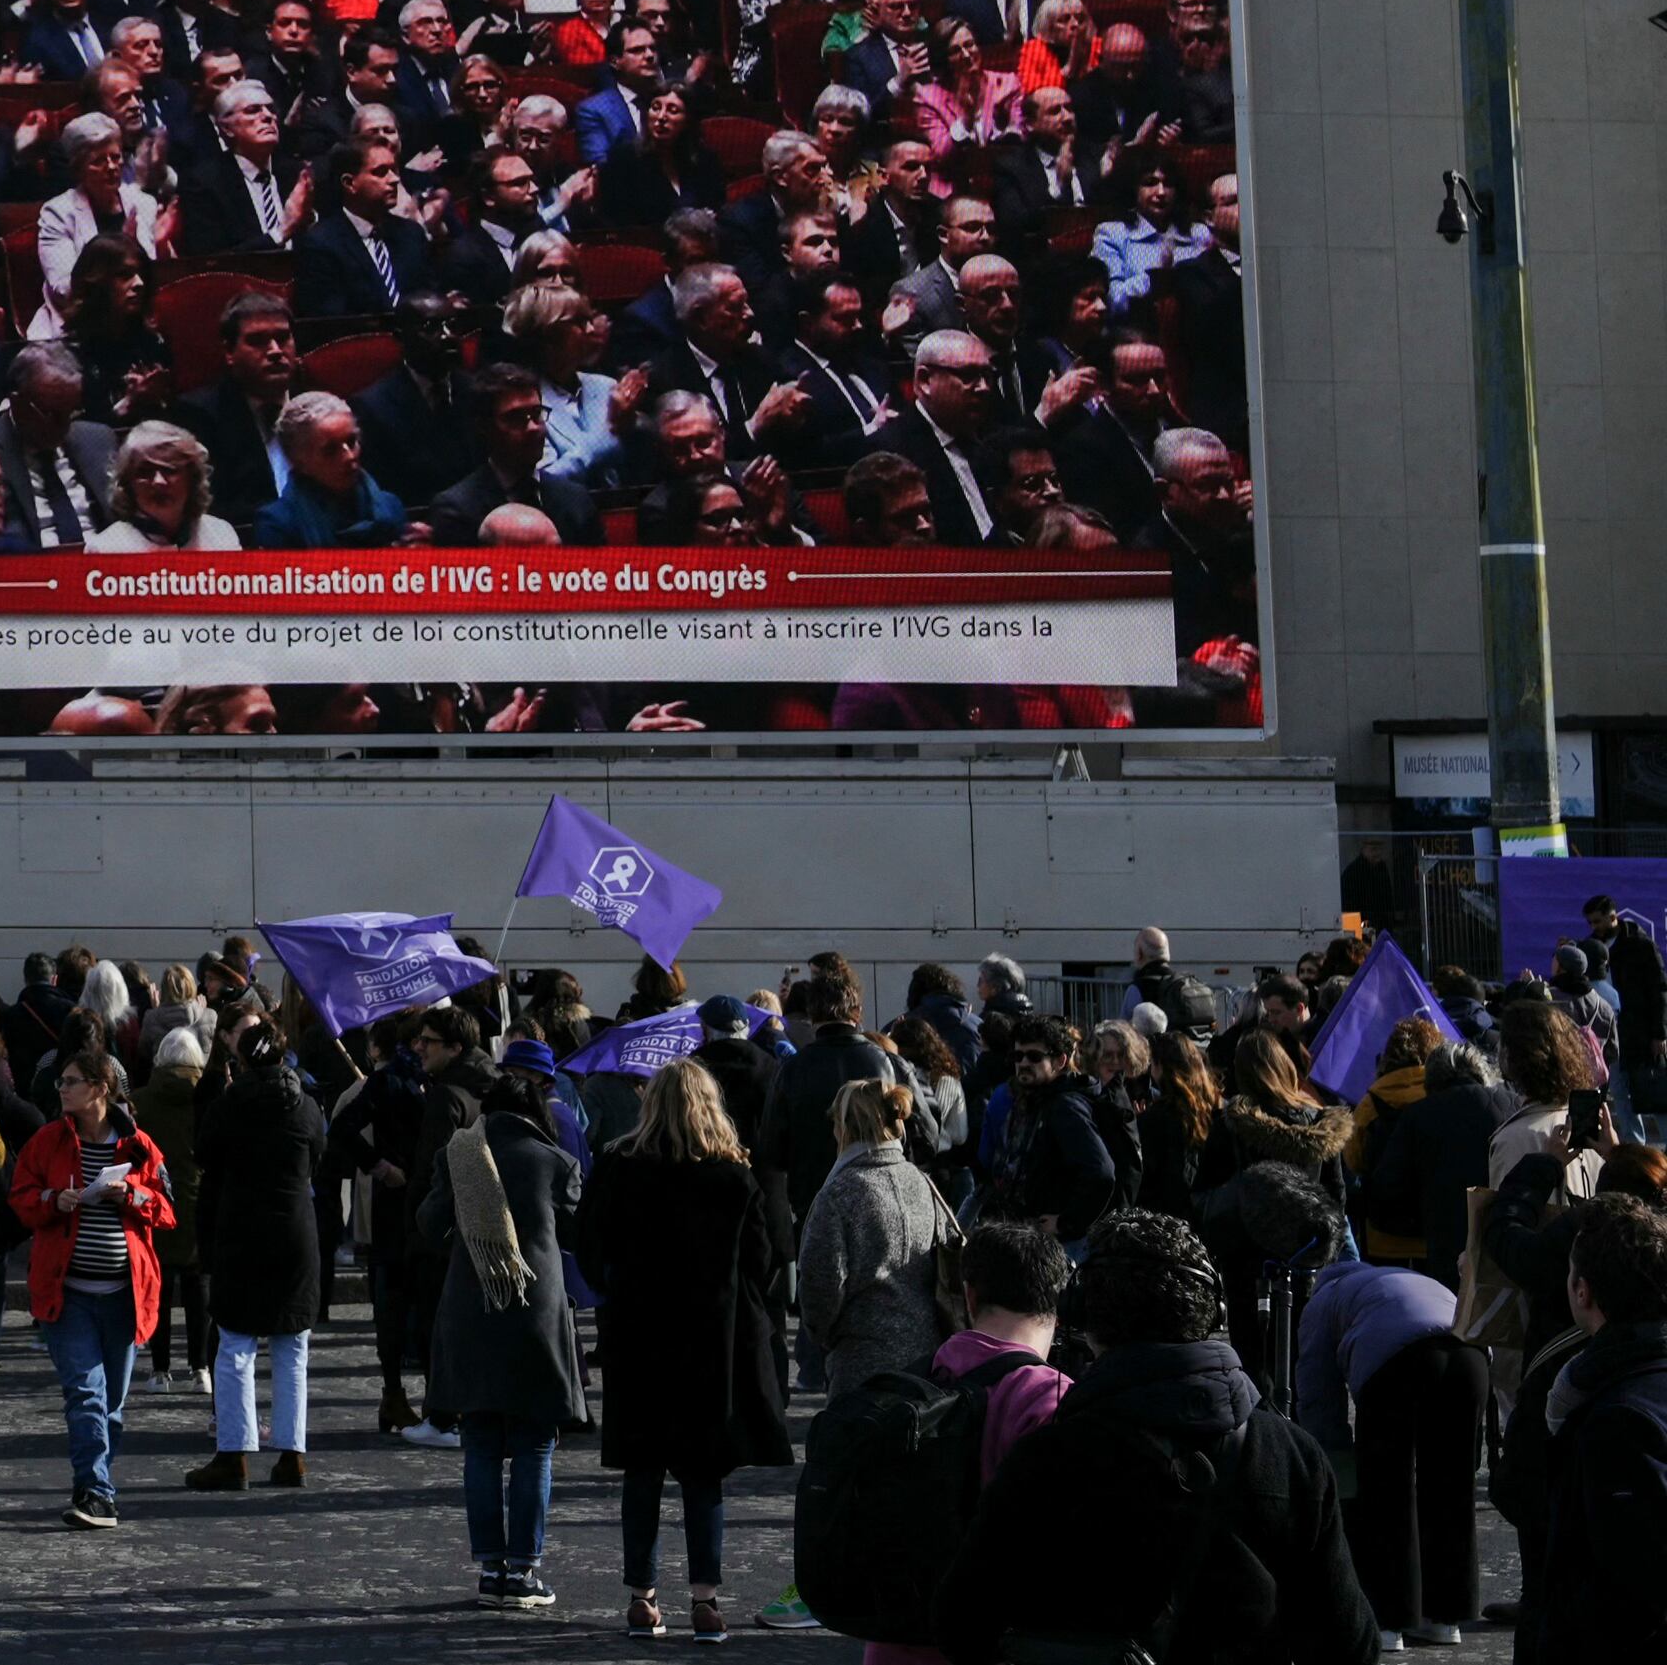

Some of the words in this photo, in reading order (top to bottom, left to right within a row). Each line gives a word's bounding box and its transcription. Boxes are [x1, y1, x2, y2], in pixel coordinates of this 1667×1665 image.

[85, 566, 385, 597] Constitutionnalisation
[392, 566, 425, 593] de
[431, 565, 493, 593] l'IVG
[518, 564, 542, 593] le
[549, 568, 607, 593] vote
[614, 563, 649, 591] du
[657, 563, 767, 599] Congrès
[27, 623, 132, 650] procède
[143, 628, 172, 644] au
[181, 624, 235, 644] vote
[246, 621, 276, 644] du
[287, 621, 363, 648] projet
[372, 620, 404, 642] de
[413, 620, 443, 642] loi
[453, 618, 668, 642] constitutionnelle
[677, 618, 753, 639] visant
[763, 617, 777, 639] à
[787, 616, 883, 639] inscrire
[893, 616, 951, 638] l'IVG
[961, 615, 1022, 637] dans
[1032, 615, 1053, 637] la
[1404, 752, 1438, 774] MUSÉE
[356, 953, 429, 986] FONDATION
[364, 990, 387, 1004] DES
[389, 971, 436, 998] FEMMES
[620, 1051, 642, 1063] DES
